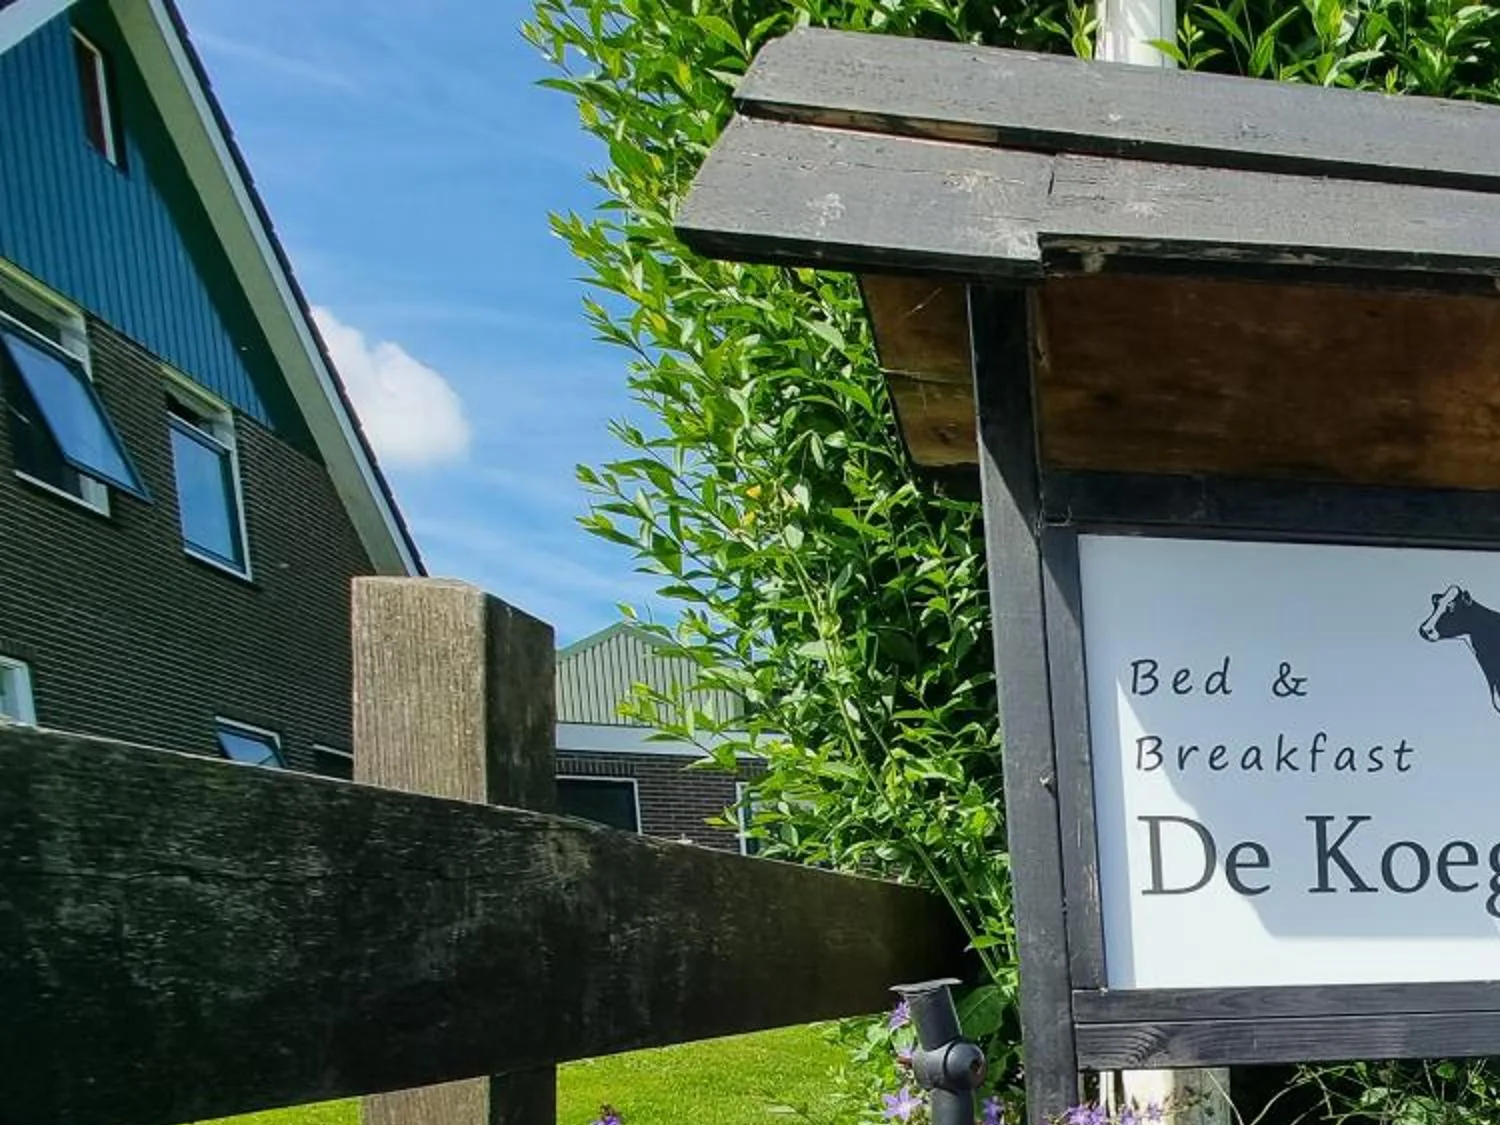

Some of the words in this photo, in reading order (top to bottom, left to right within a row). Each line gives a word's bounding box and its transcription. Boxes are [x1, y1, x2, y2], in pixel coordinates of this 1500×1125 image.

[1130, 656, 1233, 696] Bed
[1271, 661, 1308, 698] &
[1135, 732, 1415, 773] Breakfast
[1137, 815, 1271, 896] De
